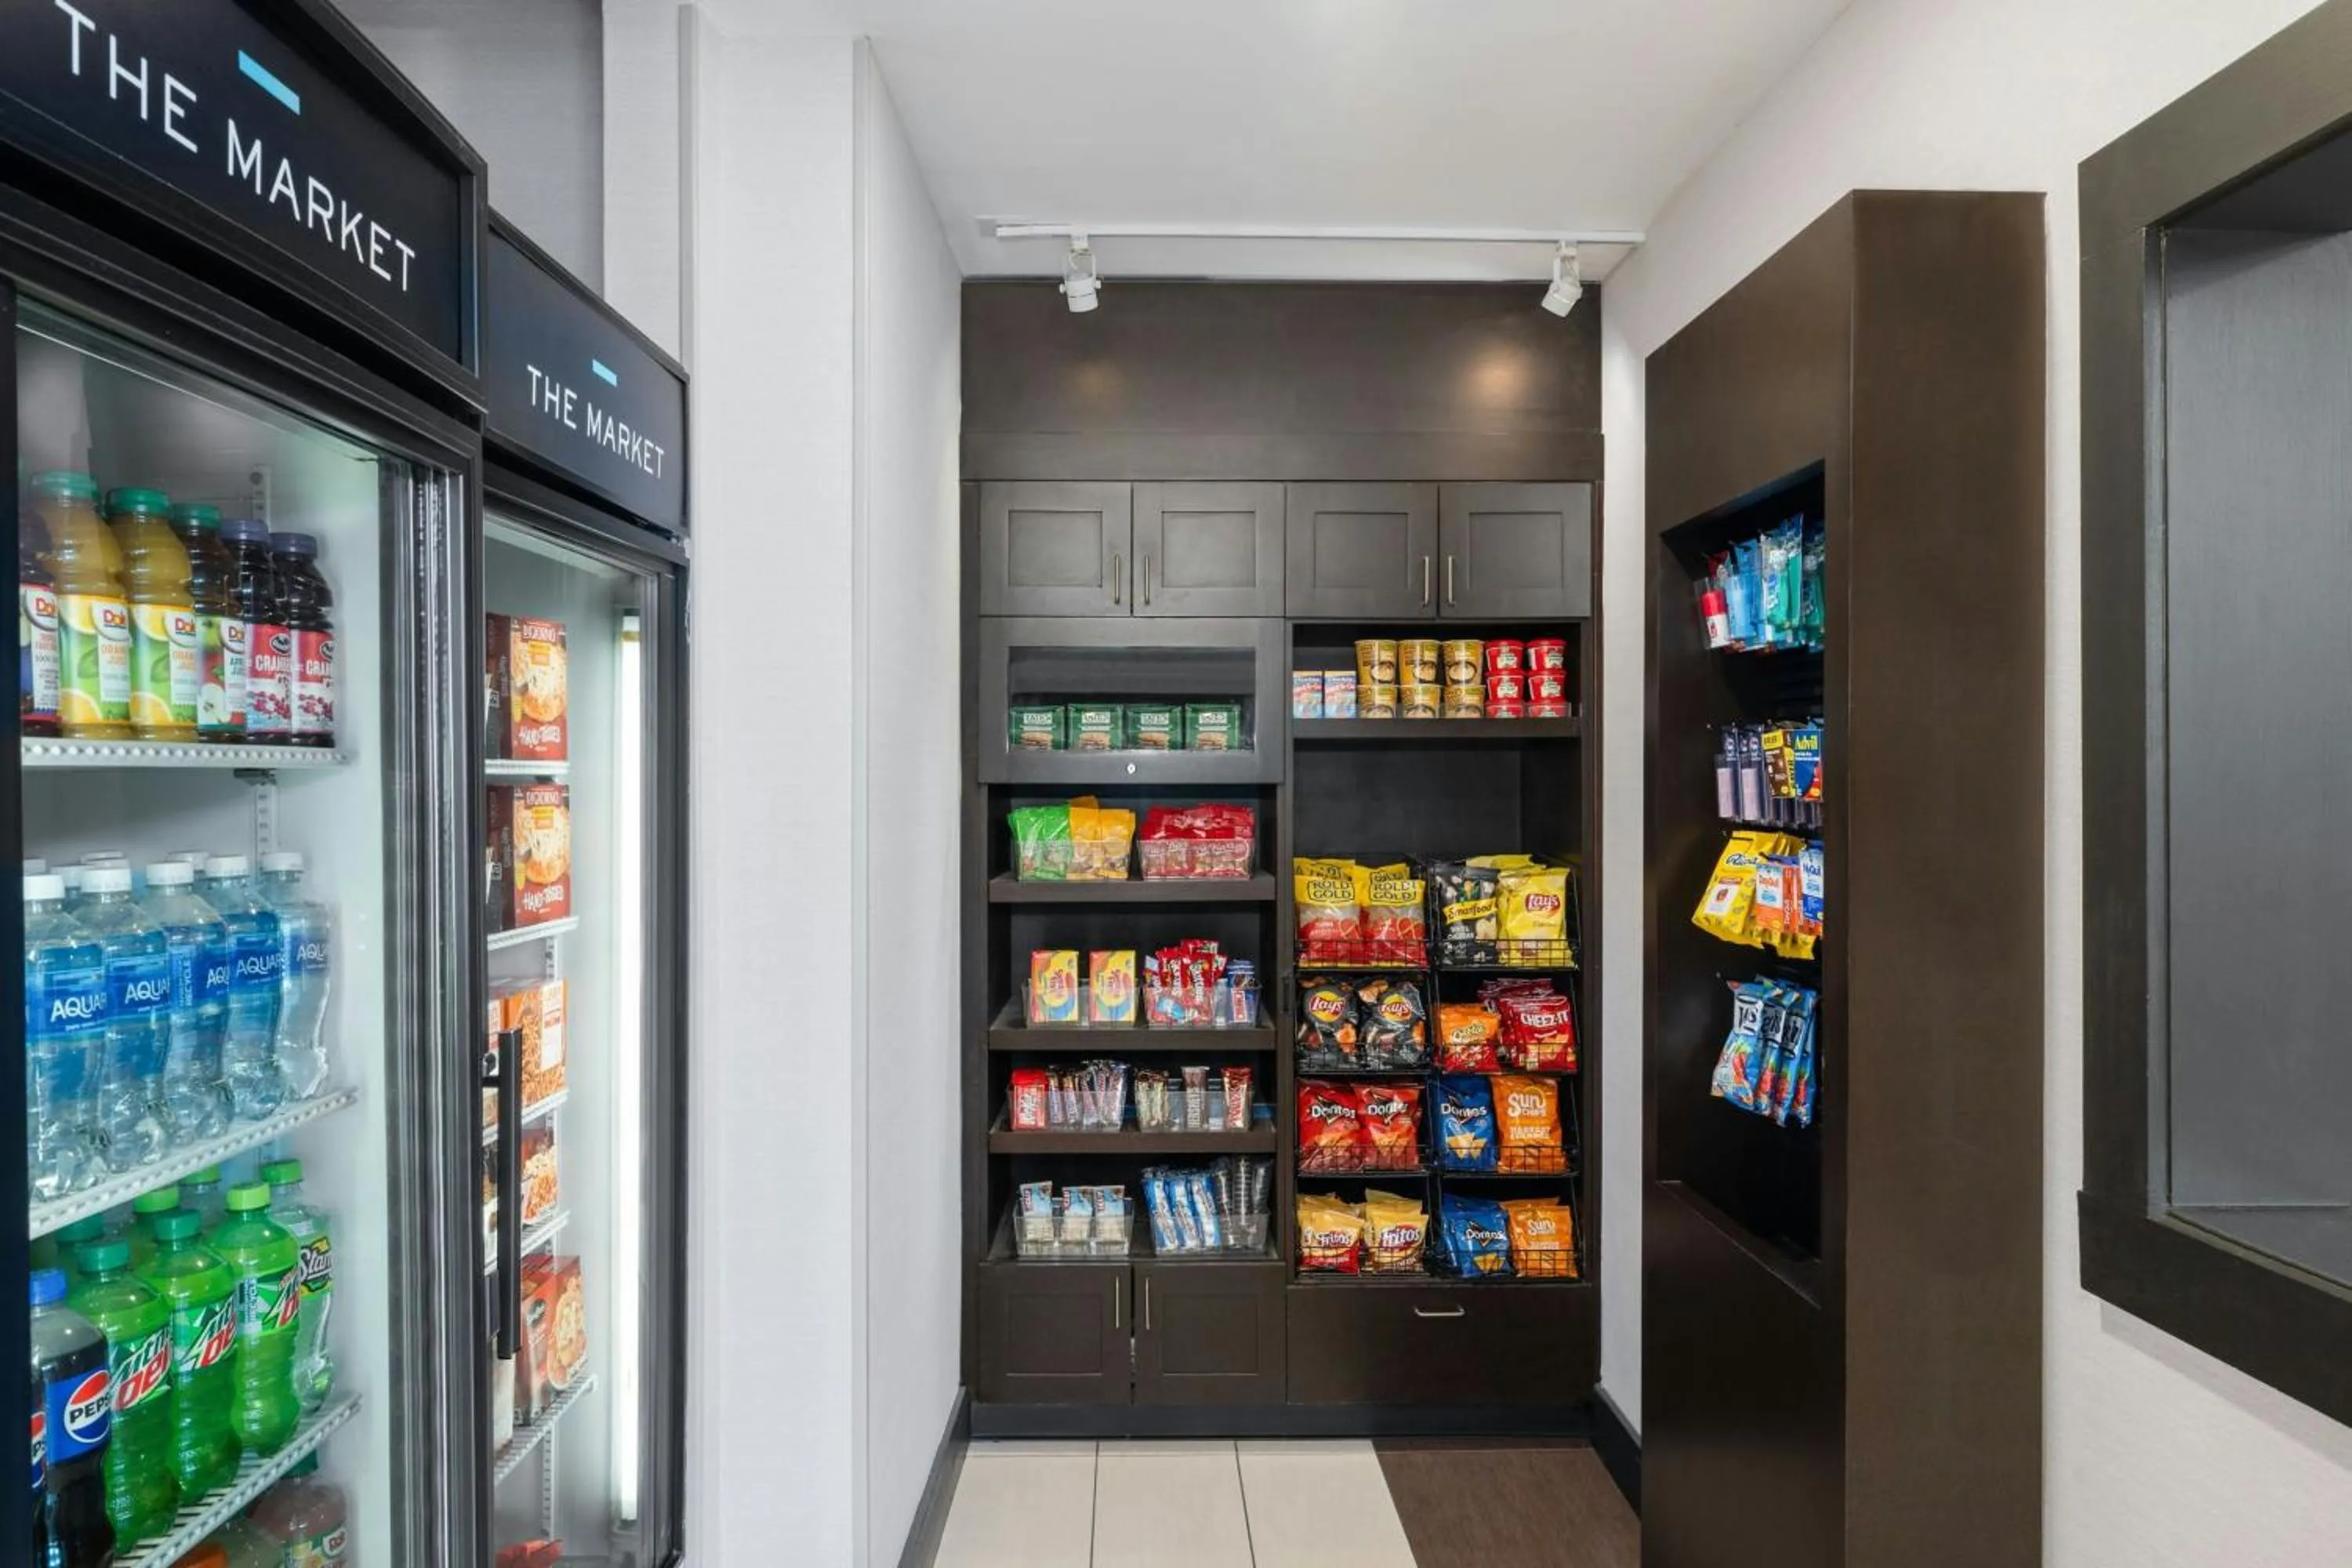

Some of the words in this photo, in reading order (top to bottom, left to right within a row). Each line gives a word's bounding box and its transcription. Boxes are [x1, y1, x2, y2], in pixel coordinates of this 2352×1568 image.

[56, 0, 198, 154] THE
[227, 118, 416, 292] MARKET
[527, 365, 578, 430] THE
[586, 402, 665, 479] MARKET
[1312, 890, 1351, 899] GOLD
[1440, 1103, 1487, 1117] Doritos
[1381, 1228, 1420, 1248] Fritos
